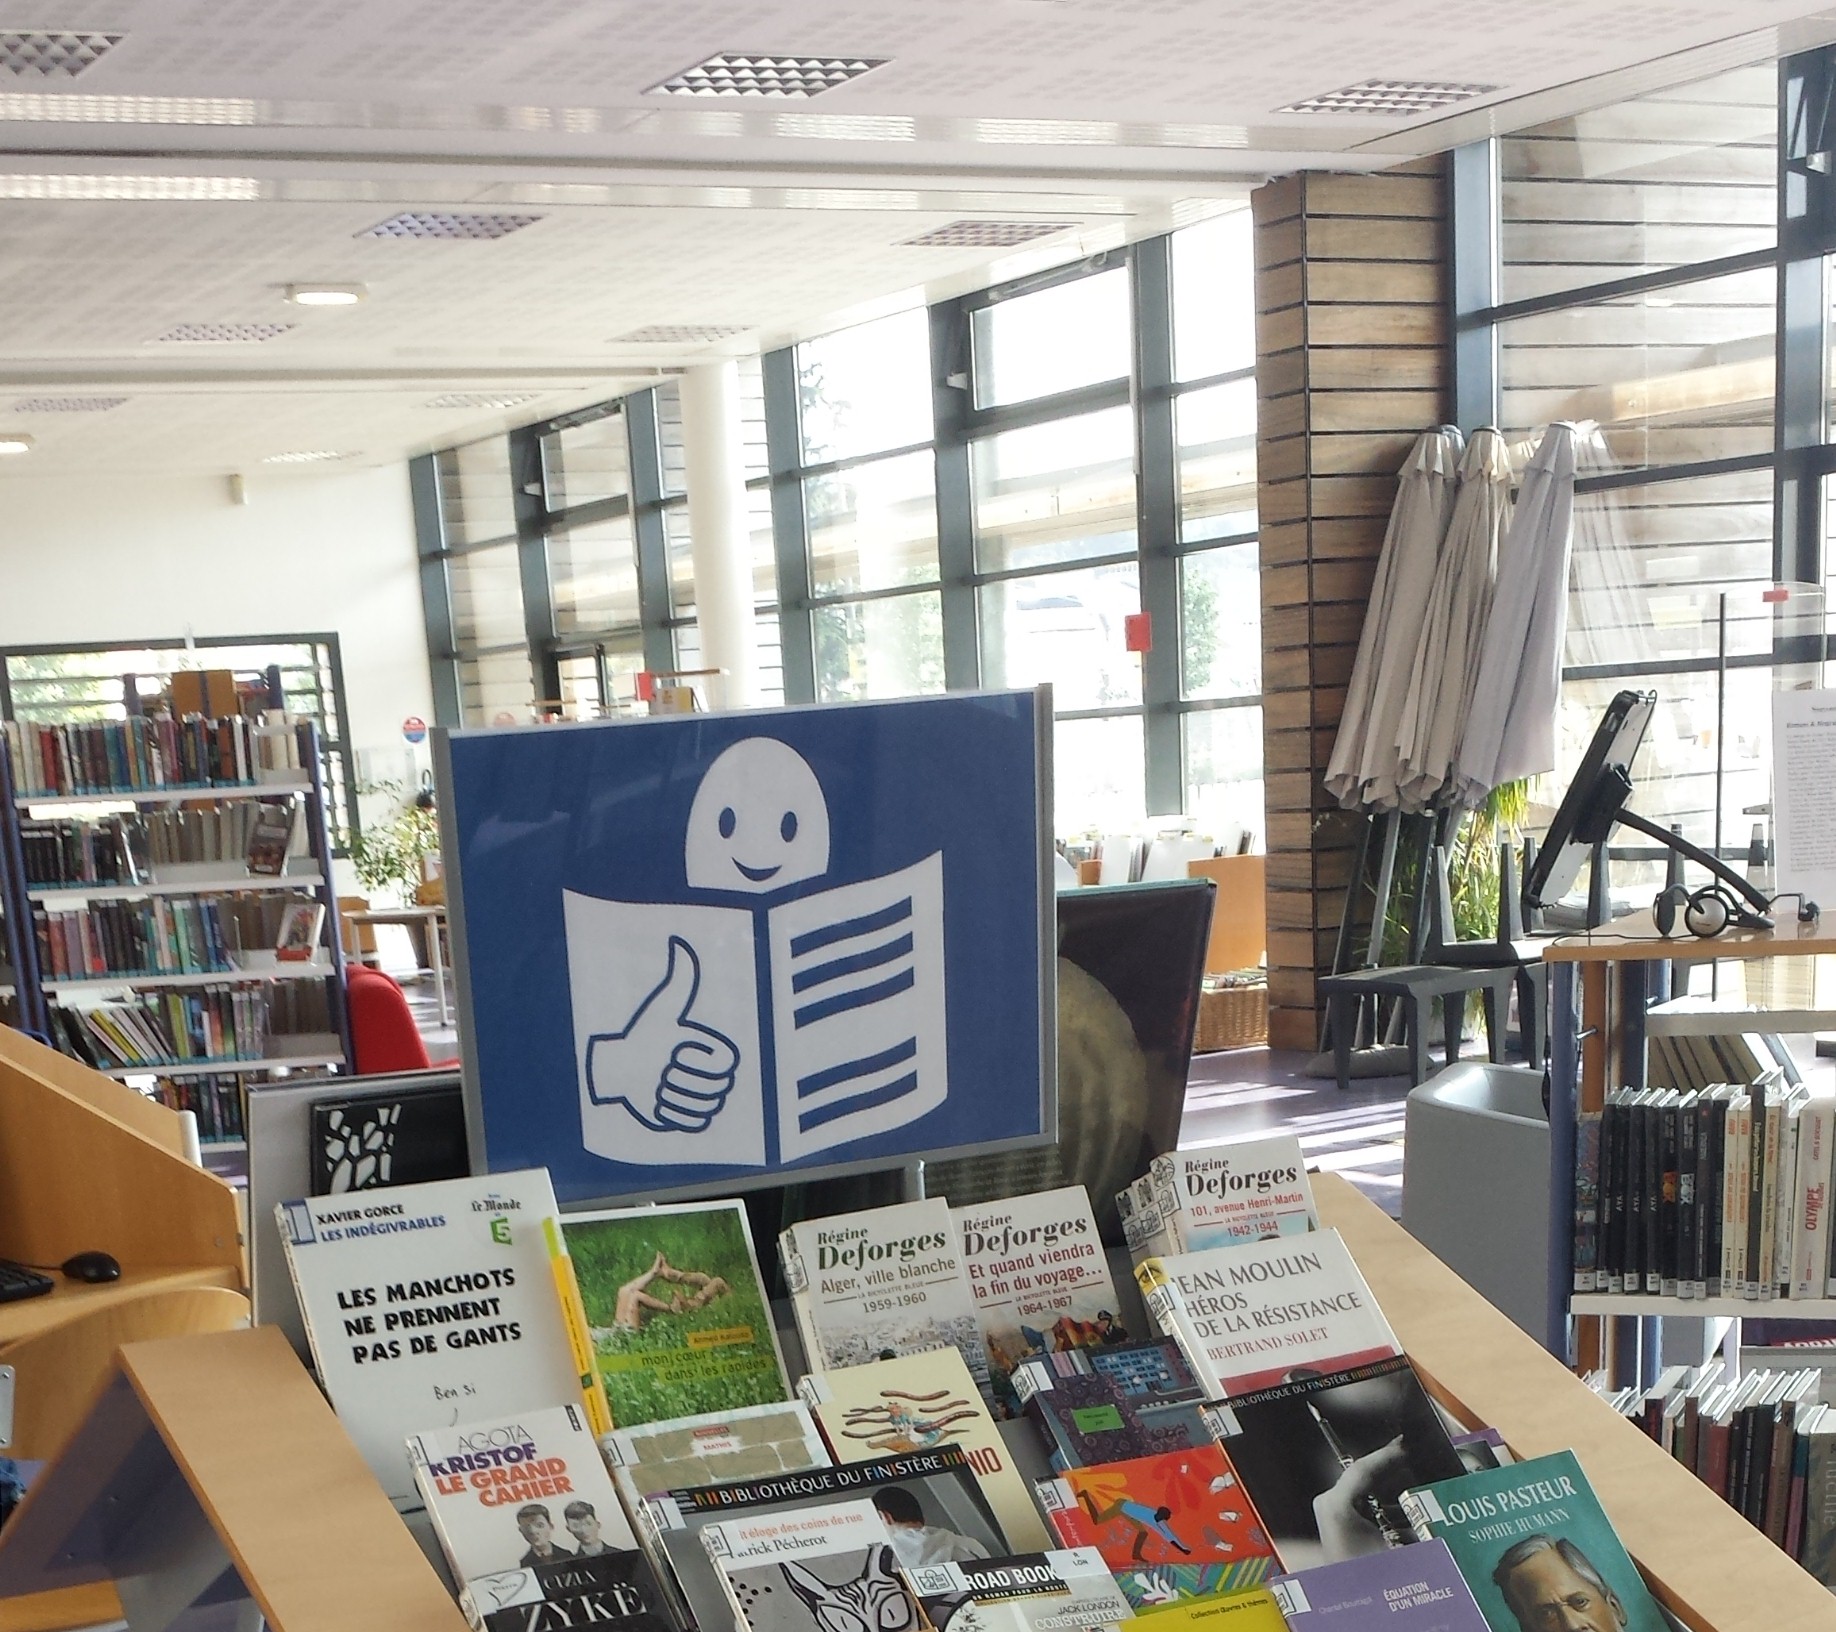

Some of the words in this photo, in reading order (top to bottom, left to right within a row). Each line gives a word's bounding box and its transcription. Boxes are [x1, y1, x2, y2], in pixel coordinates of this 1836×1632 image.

[1185, 1158, 1229, 1173] Régine
[1186, 1165, 1297, 1199] Deforges
[316, 1209, 362, 1225] XAVIER
[364, 1204, 405, 1218] GORCE
[484, 1199, 522, 1212] Monde
[1190, 1206, 1213, 1218] 101,
[1214, 1202, 1245, 1214] avenue
[1248, 1192, 1304, 1208] Henri-Martin
[1805, 1187, 1818, 1231] OLYMPE
[320, 1230, 343, 1242] LES
[346, 1214, 447, 1240] INDÉGIVRABLES
[816, 1226, 868, 1245] Régine
[963, 1213, 1013, 1234] Régine
[964, 1218, 1088, 1257] Deforges
[1227, 1220, 1279, 1237] 1942-1944
[818, 1230, 947, 1271] Deforges
[968, 1264, 986, 1280] Et
[990, 1256, 1036, 1279] quand
[1040, 1244, 1096, 1267] viendra
[336, 1288, 377, 1310] LES
[386, 1267, 516, 1304] MANCHOTS
[820, 1276, 861, 1296] Alger,
[865, 1267, 894, 1284] ville
[898, 1256, 956, 1279] blanche
[972, 1283, 988, 1299] la
[990, 1280, 1010, 1296] fin
[1014, 1276, 1032, 1292] du
[1034, 1268, 1103, 1289] voyage...
[1170, 1268, 1223, 1298] JEAN
[1228, 1252, 1322, 1288] MOULIN
[343, 1316, 377, 1338] NE
[384, 1297, 502, 1332] PRENNENT
[862, 1292, 926, 1314] 1959-1960
[1017, 1296, 1074, 1316] 1964-1967
[1184, 1292, 1248, 1319] HÉROS
[1193, 1318, 1220, 1339] DE
[1223, 1314, 1250, 1333] LA
[1254, 1291, 1362, 1328] RÉSISTANCE
[352, 1340, 402, 1364] PAS
[410, 1334, 438, 1356] DE
[446, 1322, 522, 1350] GANTS
[1206, 1332, 1283, 1361] BERTRAND
[1286, 1326, 1330, 1347] SOLET
[641, 1355, 670, 1367] mon
[676, 1350, 707, 1364] cœur
[664, 1368, 694, 1382] dans
[700, 1364, 720, 1378] les
[722, 1357, 767, 1374] rapides
[434, 1384, 458, 1400] Ben
[1226, 1387, 1291, 1410] BIBLIOTHÈQUE
[1292, 1384, 1306, 1396] DU
[1306, 1373, 1352, 1392] FINISTÈRE
[457, 1424, 533, 1454] AGOTA
[428, 1442, 538, 1477] KRISTOF
[434, 1474, 466, 1496] LE
[470, 1456, 568, 1490] GRAND
[719, 1474, 835, 1505] BIBLIOTHÈQUE
[836, 1469, 862, 1486] DU
[864, 1454, 943, 1482] FINISTÈRE
[478, 1475, 575, 1507] CAHIER
[1442, 1494, 1497, 1528] LOUIS
[1498, 1476, 1577, 1514] PASTEUR
[748, 1524, 779, 1538] éloge
[780, 1522, 798, 1534] des
[801, 1518, 829, 1531] coins
[831, 1516, 844, 1526] de
[845, 1513, 864, 1524] rue
[1468, 1522, 1514, 1544] SOPHIE
[1516, 1508, 1571, 1534] HUMANN
[775, 1535, 828, 1552] Pécherot
[963, 1569, 1012, 1592] ROAD
[1014, 1564, 1062, 1584] BOOK
[1382, 1582, 1430, 1602] ÉQUATION
[1057, 1604, 1080, 1616] JACK
[1082, 1600, 1121, 1612] LONDON
[1388, 1596, 1415, 1613] D'UN
[1414, 1587, 1454, 1605] MIRACLE
[1034, 1608, 1128, 1631] CONSTRUIRE
